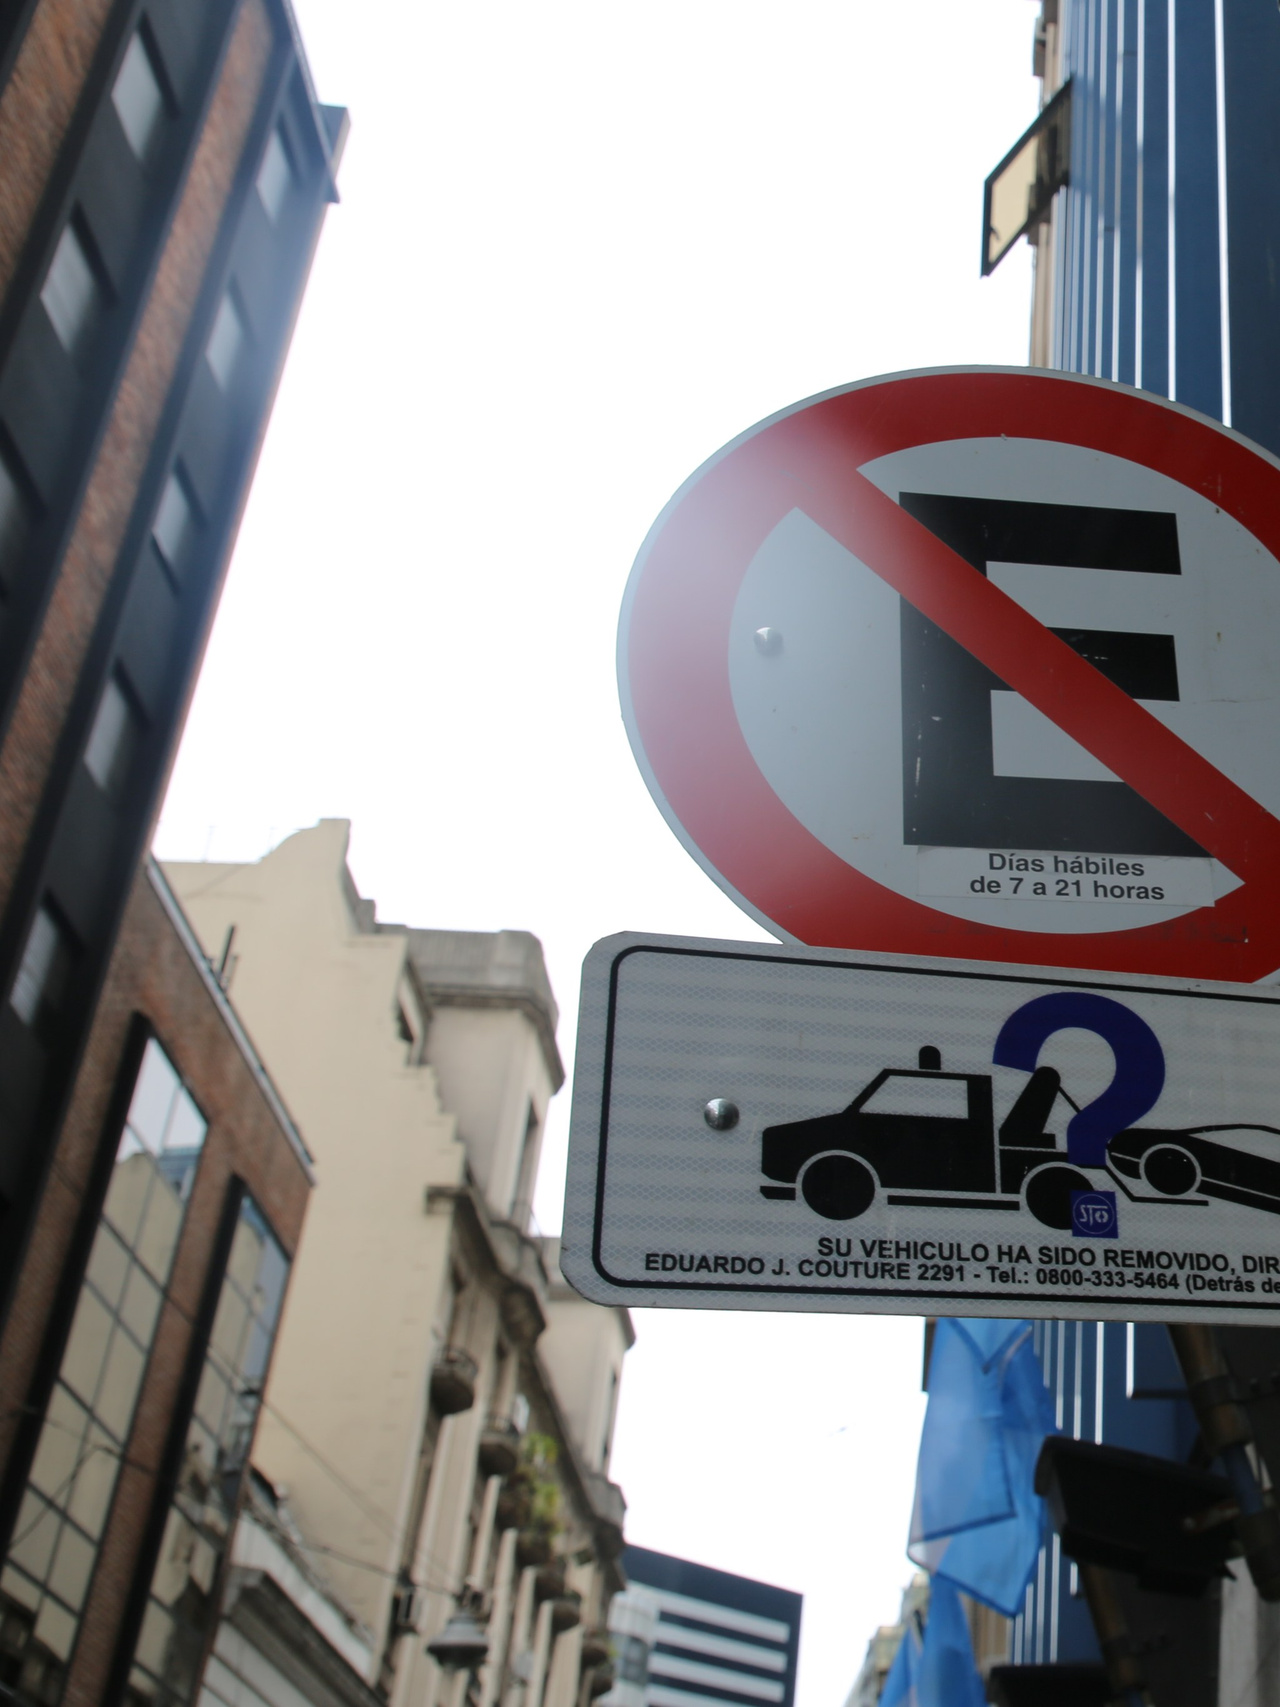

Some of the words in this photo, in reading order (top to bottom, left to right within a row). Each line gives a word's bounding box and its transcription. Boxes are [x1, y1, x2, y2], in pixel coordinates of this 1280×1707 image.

[899, 491, 1213, 858] E
[988, 853, 1045, 873] Días
[1053, 855, 1145, 877] hábiles
[969, 876, 1001, 894] de
[1008, 877, 1024, 895] 7
[1032, 882, 1047, 896] a
[1055, 879, 1082, 897] 21
[1093, 880, 1165, 901] horas
[644, 1253, 765, 1276] EDUARDO
[771, 1258, 791, 1277] J.
[798, 1259, 911, 1280] COUTURE
[917, 1264, 965, 1282] 2291
[986, 1264, 1029, 1285] Tel.:
[1036, 1267, 1180, 1290] 0800-333-5464
[1185, 1274, 1256, 1295] (Detrás
[817, 1237, 852, 1257] SU
[859, 1240, 989, 1263] VEHICULO
[997, 1244, 1032, 1264] HA
[1038, 1246, 1097, 1267] SIDO
[1104, 1250, 1236, 1276] REMOVIDO,
